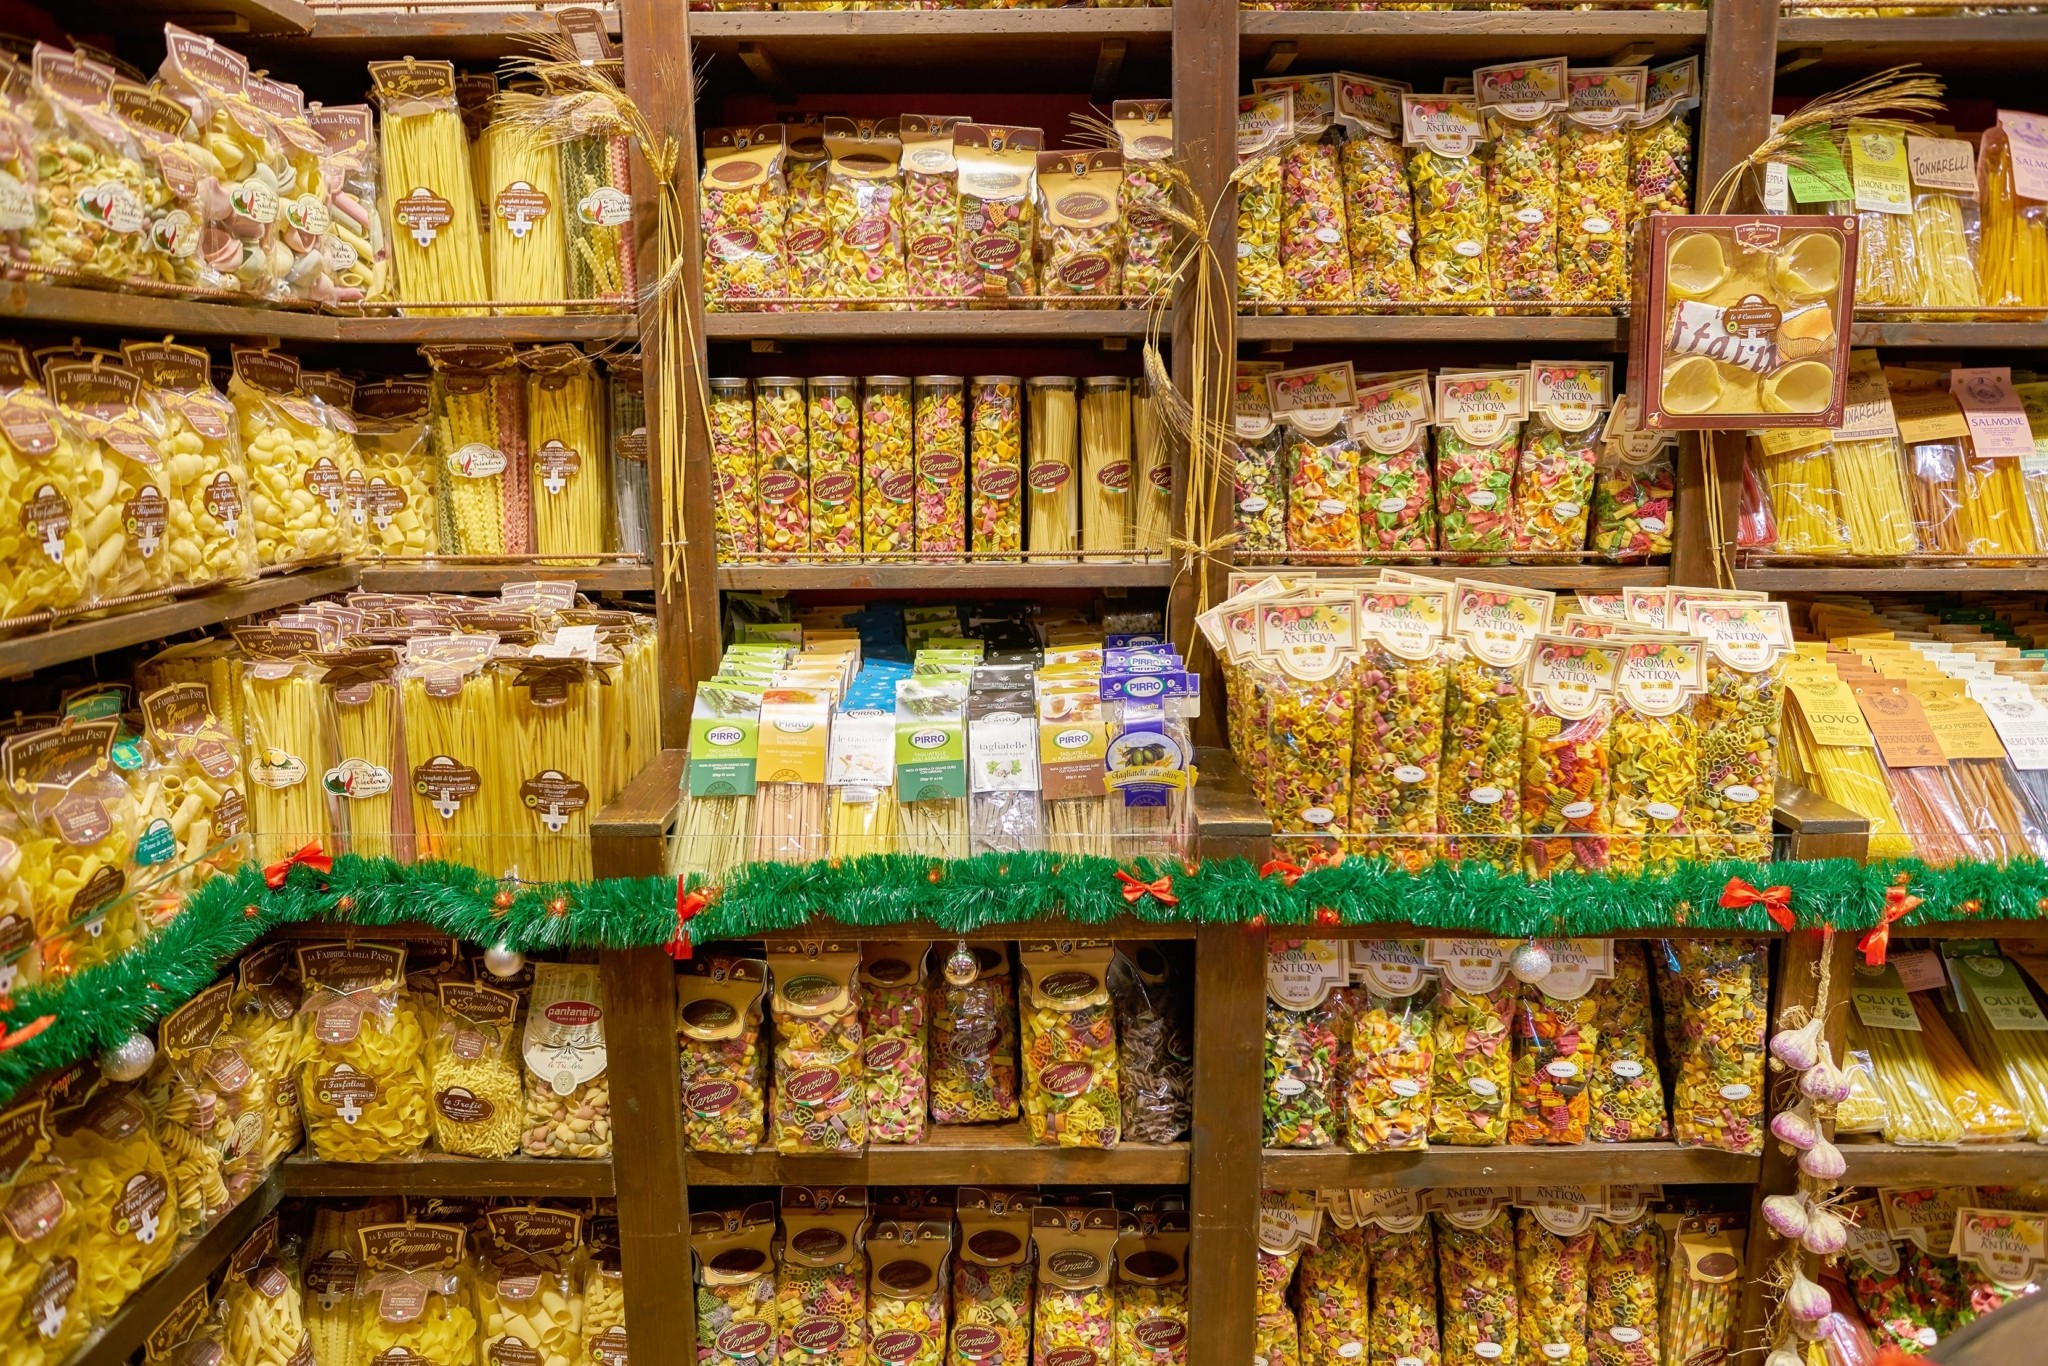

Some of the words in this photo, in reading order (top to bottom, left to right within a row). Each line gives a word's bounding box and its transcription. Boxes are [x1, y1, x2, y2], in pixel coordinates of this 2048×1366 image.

[1503, 81, 1540, 95] ROMA
[1580, 88, 1617, 100] ROMA
[1498, 90, 1546, 101] ANTIQVA
[1573, 99, 1621, 108] ANTIQVA
[1238, 112, 1267, 122] OMA
[1429, 114, 1461, 123] ROMA
[1426, 123, 1468, 134] ANTIQVA
[1913, 155, 1971, 178] TONNARELLI
[1766, 174, 1785, 186] EPPIA
[1857, 179, 1884, 192] LIMONE
[1891, 183, 1908, 194] PEPE
[184, 354, 202, 368] PASTA
[113, 374, 132, 391] PASTA
[1557, 381, 1588, 392] ROMA
[1297, 385, 1330, 396] ROMA
[1550, 390, 1593, 402] ANTIQVA
[1238, 393, 1263, 402] OMA
[1291, 393, 1336, 406] ANTIQVA
[1467, 391, 1501, 403] ROMA
[1371, 400, 1404, 415] ROMA
[1458, 402, 1506, 414] ANTIQVA
[1842, 397, 1888, 426] NNARELLI
[1365, 409, 1412, 427] ANTIQVA
[1971, 417, 2025, 427] SALMONE
[1384, 609, 1423, 620] ROMA
[1483, 607, 1519, 619] ROMA
[1290, 620, 1330, 632] ROMA
[1380, 620, 1430, 632] ANTIQVA
[1473, 619, 1526, 635] ANTIQVA
[1722, 621, 1760, 631] ROMA
[293, 633, 314, 642] PASTA
[469, 639, 489, 647] PASTA
[1281, 632, 1337, 645] ANTIQVA
[1716, 632, 1769, 643] ANTIQVA
[1131, 641, 1158, 649] PIRRO
[1558, 659, 1594, 671] ROMA
[1635, 657, 1675, 669] ROMA
[1548, 671, 1598, 685] ANTIQVA
[1627, 670, 1681, 682] ANTIQVA
[1129, 683, 1161, 693] PIRRO
[1809, 714, 1860, 725] UOVO
[1954, 721, 1988, 730] PORCINO
[87, 730, 107, 742] PASTA
[710, 731, 742, 742] PIRRO
[914, 734, 946, 744] PIRRO
[1059, 734, 1090, 745] PIRRO
[1915, 735, 1935, 744] ROSSO
[2006, 738, 2026, 746] NERO
[1111, 769, 1149, 781] Tagliatelle
[1150, 770, 1162, 778] alle
[1162, 770, 1179, 778] olive
[1375, 941, 1411, 954] ROMA
[1449, 946, 1503, 959] ANTIQVA
[1543, 940, 1582, 953] ROMA
[316, 950, 351, 961] FABBRICA
[352, 951, 370, 959] DELLA
[371, 950, 394, 963] PASTA
[1279, 951, 1317, 961] ROMA
[1369, 951, 1419, 966] ANTIQVA
[1550, 953, 1589, 965] NTIQVA
[1270, 962, 1323, 975] ANTIQVA
[493, 994, 509, 1007] PASTA
[1856, 993, 1908, 1007] OLIVE
[1983, 995, 2034, 1006] OLIVE
[548, 1007, 601, 1021] pantanella
[327, 1080, 367, 1090] Farfalloni
[455, 1101, 483, 1110] Trofie
[1446, 1186, 1494, 1200] ANTIQVA
[1535, 1189, 1587, 1203] ANTIQVA
[1262, 1194, 1295, 1211] ROMA
[1913, 1200, 1951, 1212] ROMA
[551, 1214, 572, 1227] PASTA
[1261, 1205, 1299, 1225] NTIQVA
[378, 1231, 412, 1242] FABBRICA
[431, 1231, 454, 1243] PASTA
[1984, 1228, 2024, 1241] ROMA
[1980, 1239, 2031, 1253] ANTIQVA
